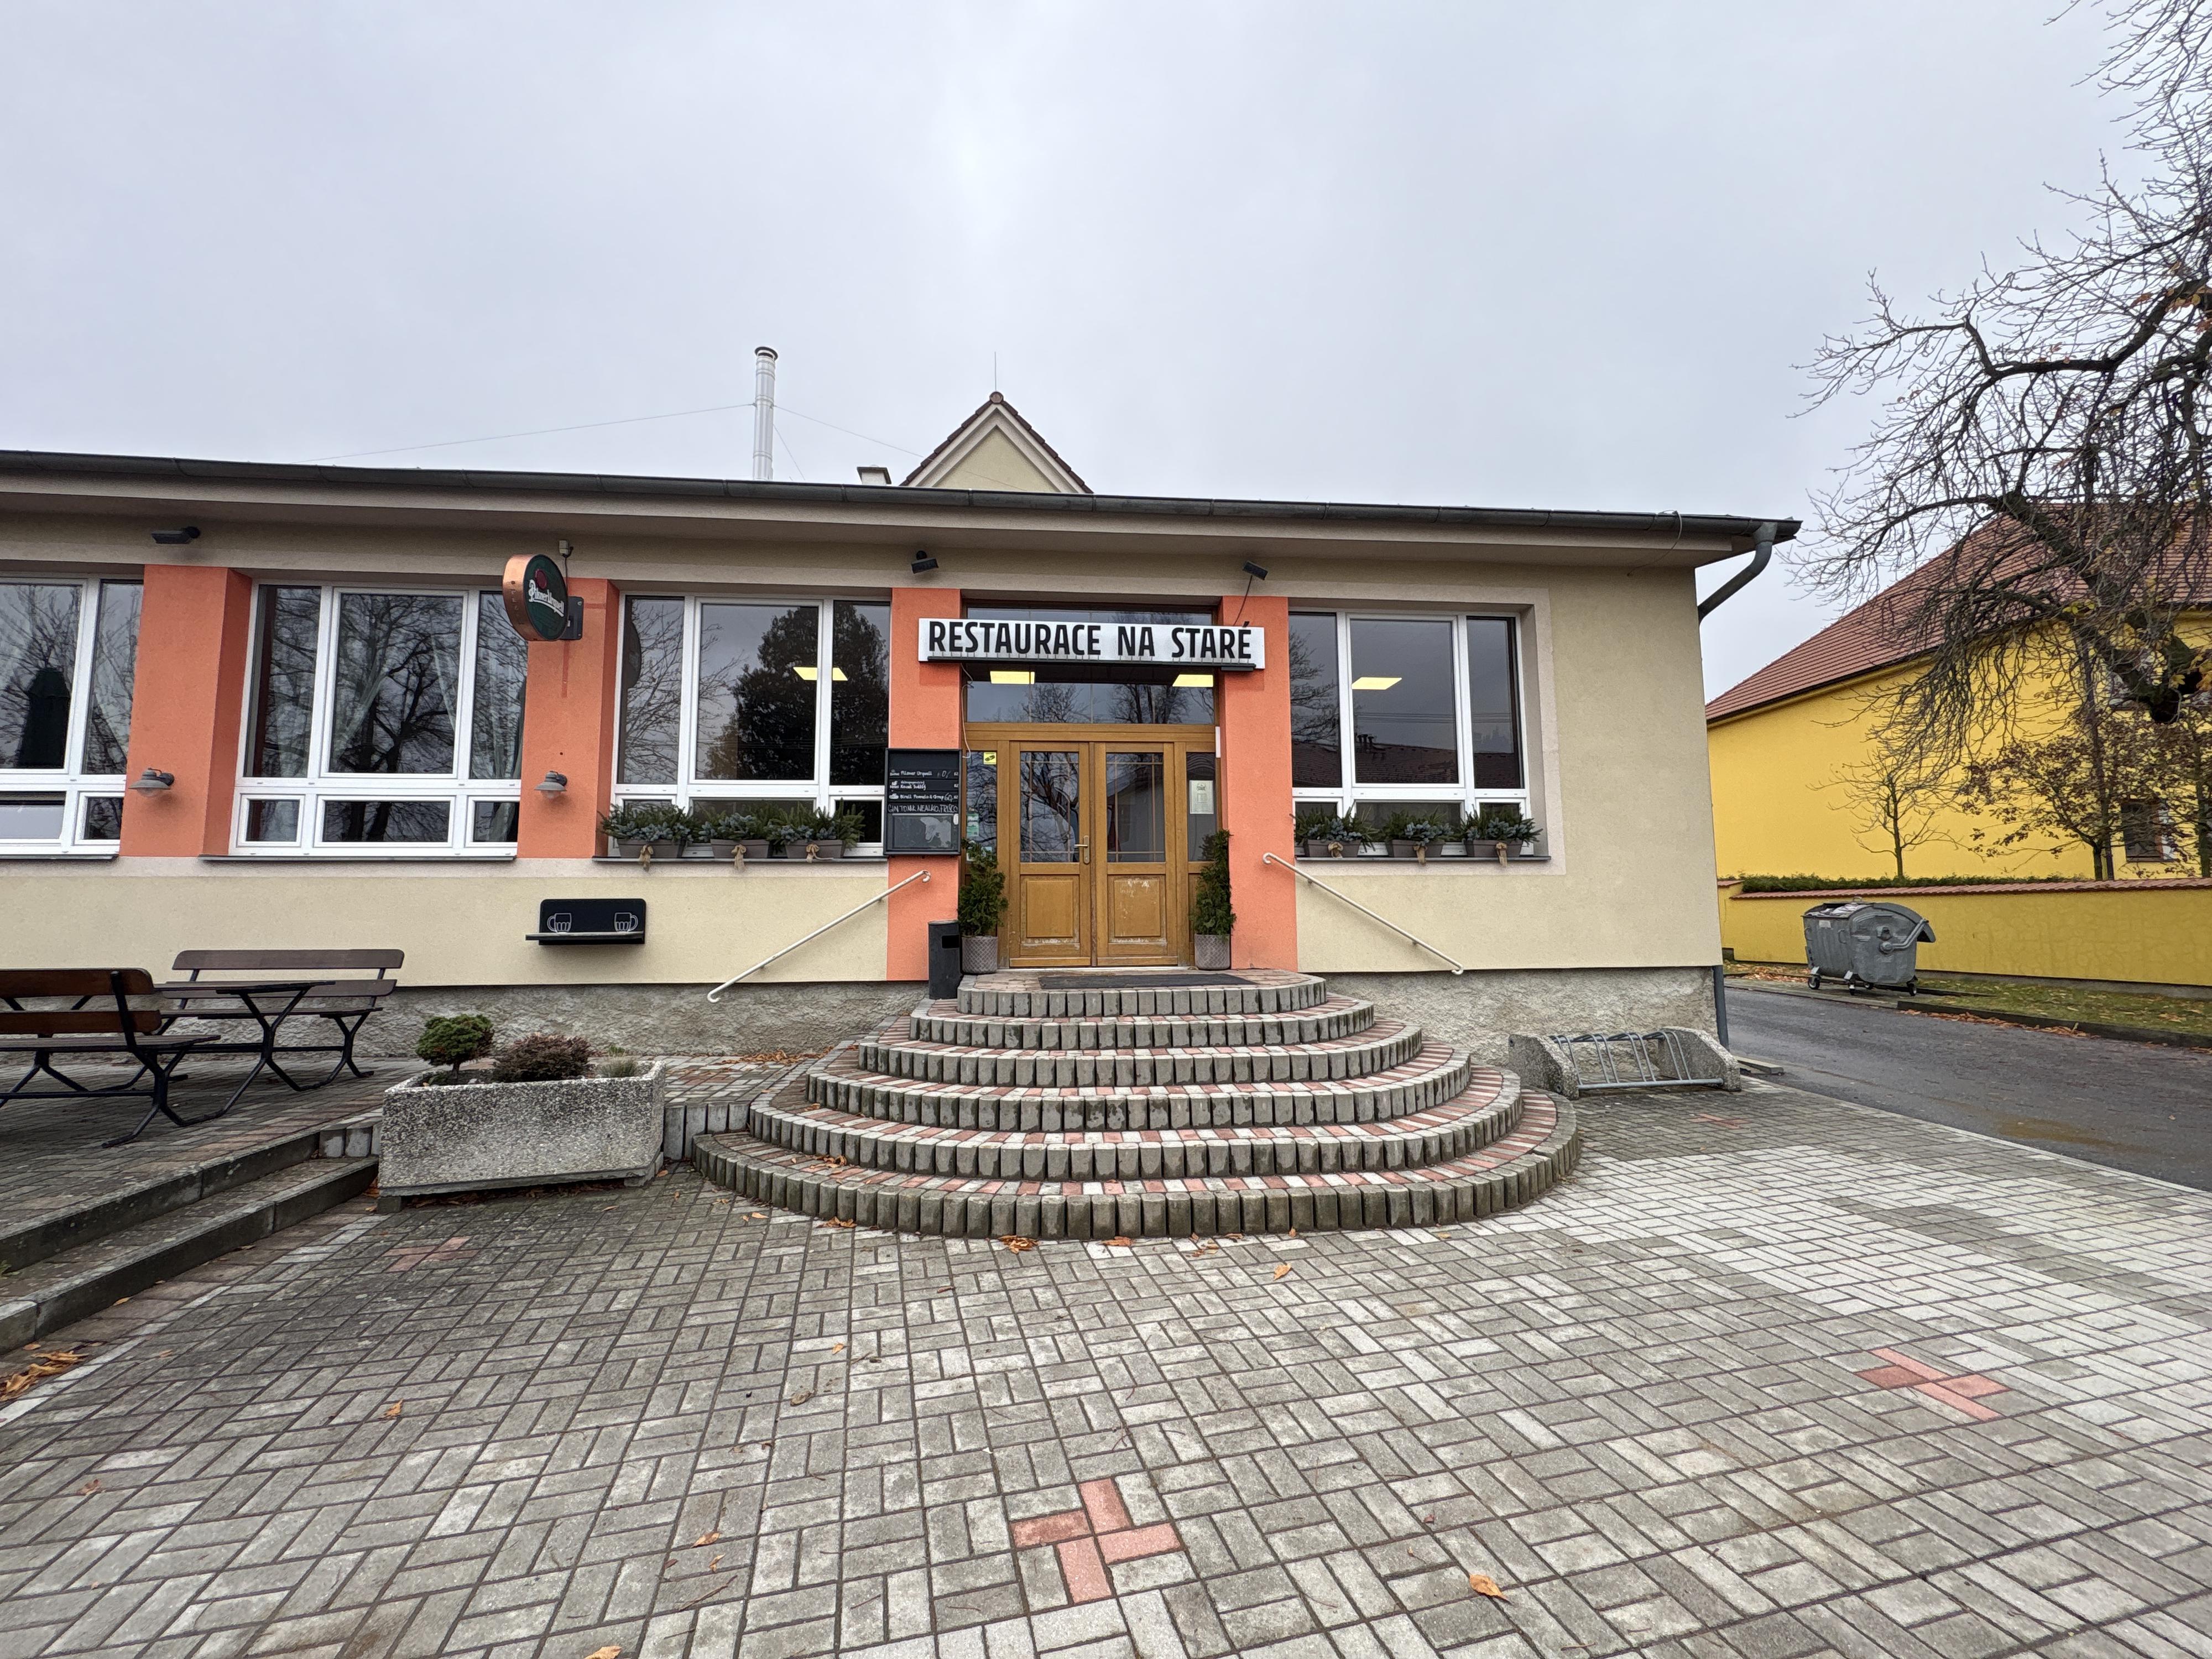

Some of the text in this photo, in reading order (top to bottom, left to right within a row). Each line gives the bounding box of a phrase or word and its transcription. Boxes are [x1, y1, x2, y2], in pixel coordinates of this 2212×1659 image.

[528, 579, 548, 602] Pilsner
[547, 589, 565, 613] Urquell
[928, 620, 1251, 659] RESTAURACE NA STARÉ
